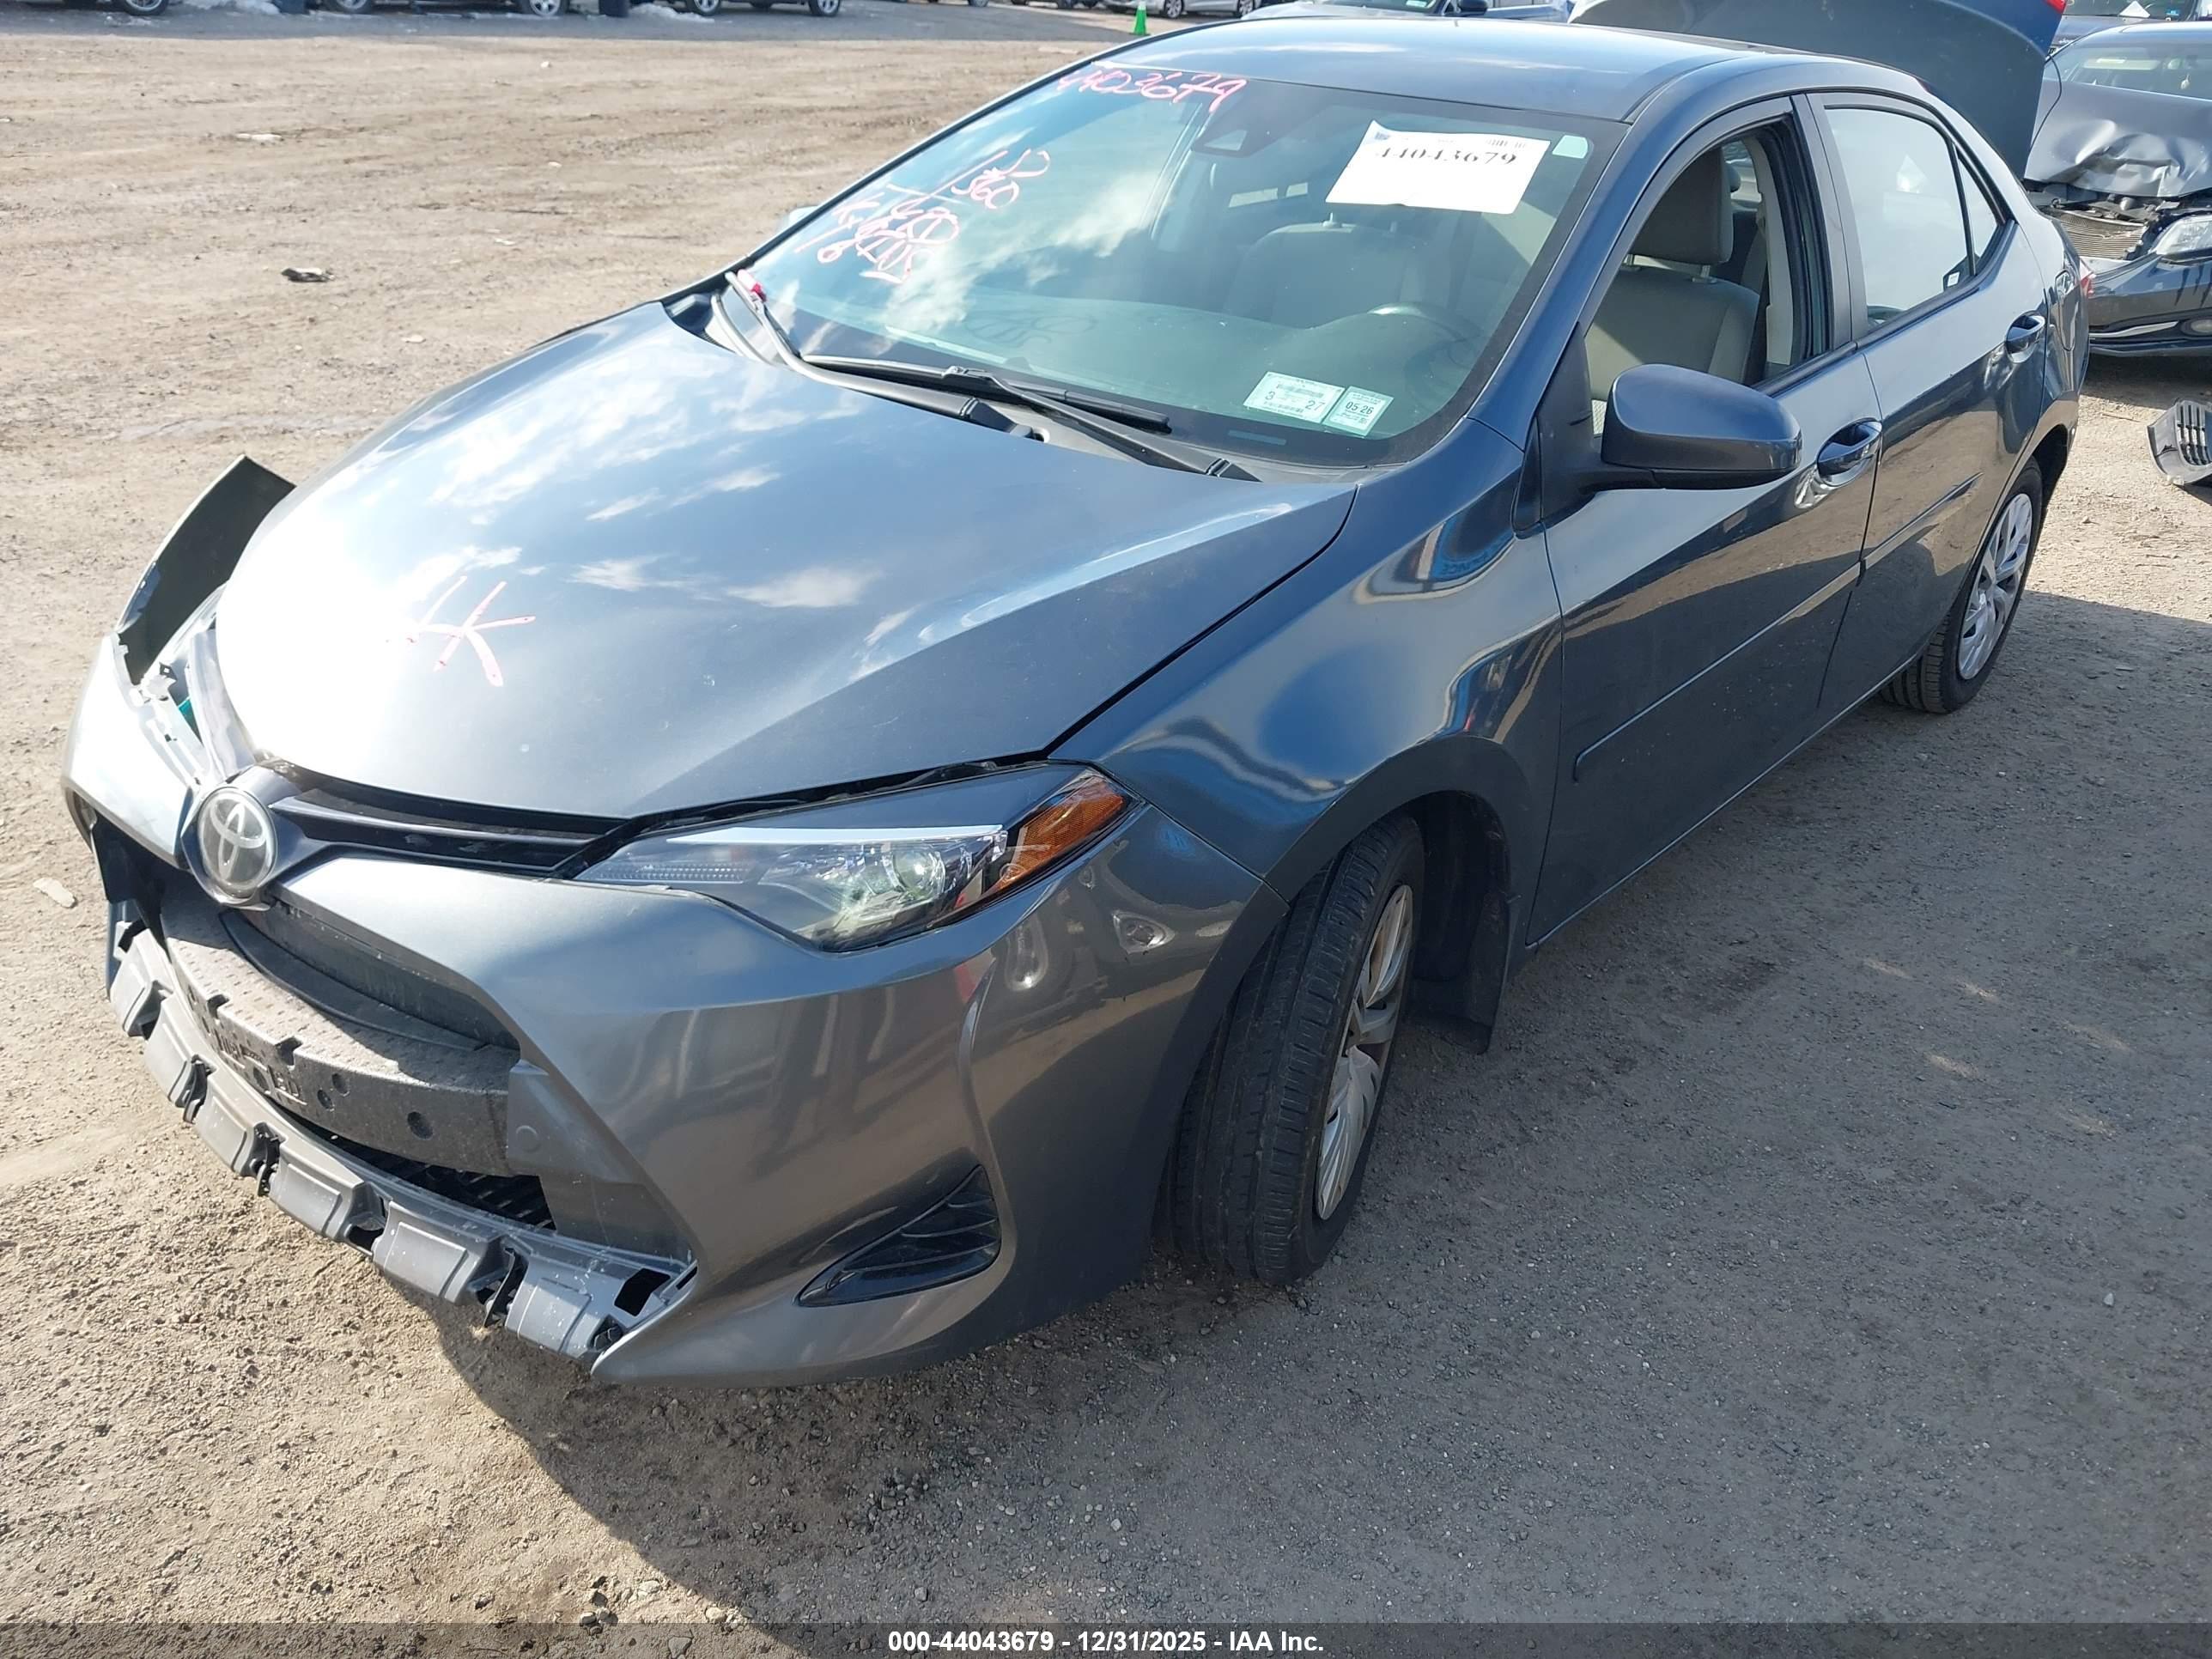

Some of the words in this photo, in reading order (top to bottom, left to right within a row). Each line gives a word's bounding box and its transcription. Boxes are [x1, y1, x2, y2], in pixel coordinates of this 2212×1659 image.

[1304, 399, 1326, 411] 27
[1346, 401, 1358, 411] 05
[1362, 404, 1375, 416] 26
